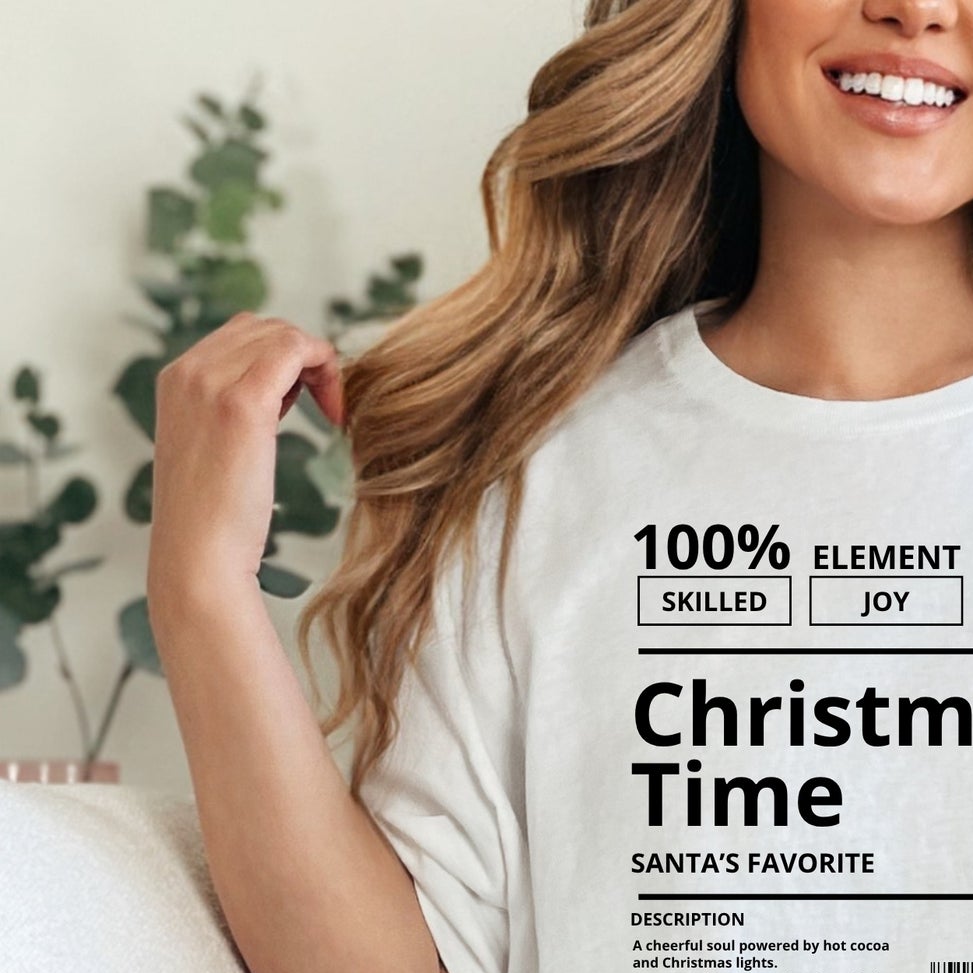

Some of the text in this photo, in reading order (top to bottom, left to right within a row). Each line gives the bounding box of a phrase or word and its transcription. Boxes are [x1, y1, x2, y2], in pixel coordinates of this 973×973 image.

[633, 523, 791, 571] 100%
[814, 545, 962, 570] ELEMENT
[662, 591, 767, 612] SKILLED
[860, 591, 910, 618] JOY
[631, 758, 843, 828] Time
[748, 852, 875, 874] FAVORITE
[630, 912, 745, 927] DESCRIPTION
[632, 939, 890, 955] A cheerful soul powered by hot cocoa
[632, 956, 778, 972] and Christmas lights.
